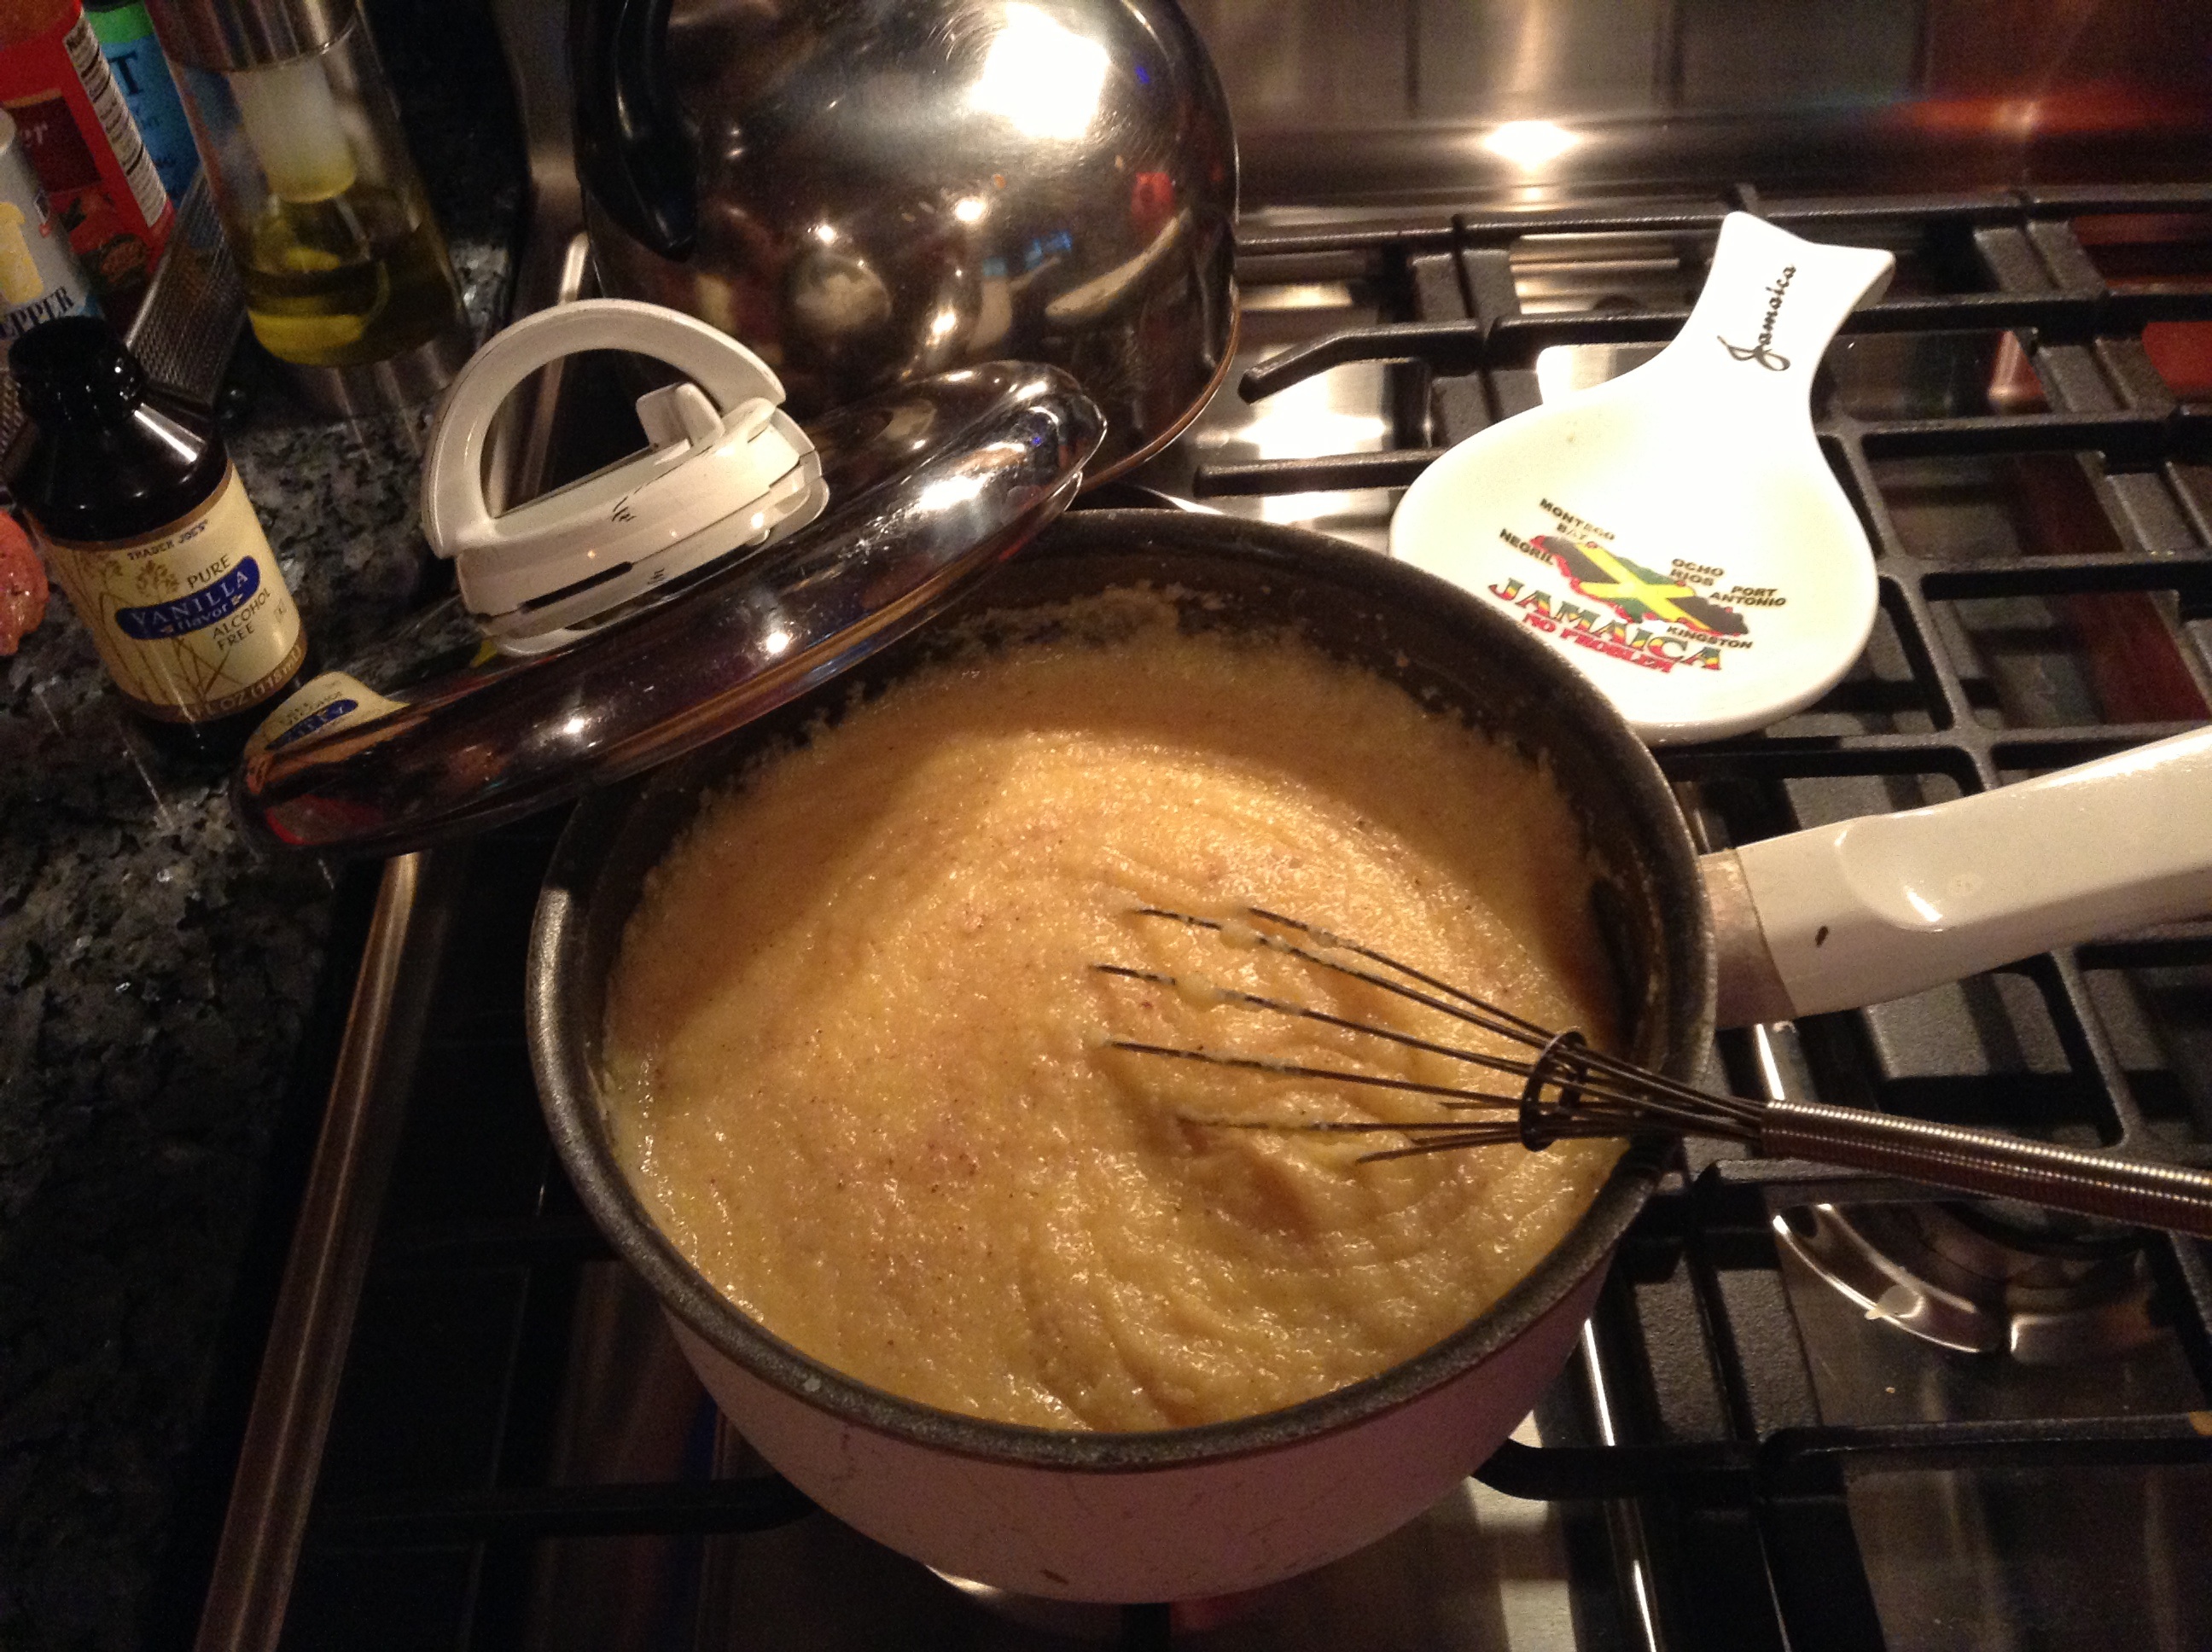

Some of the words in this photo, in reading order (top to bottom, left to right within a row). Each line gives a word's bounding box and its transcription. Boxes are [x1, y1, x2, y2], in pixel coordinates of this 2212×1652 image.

[1717, 265, 1796, 371] Jamaica
[1539, 497, 1615, 542] MONTEGO
[1499, 528, 1554, 566] NEGRIL
[186, 554, 231, 589] PURE
[1669, 568, 1715, 586] RIOS
[1671, 558, 1724, 578] OCHO
[130, 570, 248, 626] VANILLA
[1709, 591, 1787, 608] ANTONIO
[1732, 585, 1778, 597] PORT
[177, 603, 229, 631] flavor
[213, 588, 271, 640] ALCOHOL
[1487, 578, 1722, 671] JAMAICA
[1522, 613, 1557, 634] NO
[218, 621, 255, 651] FREE
[1666, 625, 1753, 649] KINGSTON
